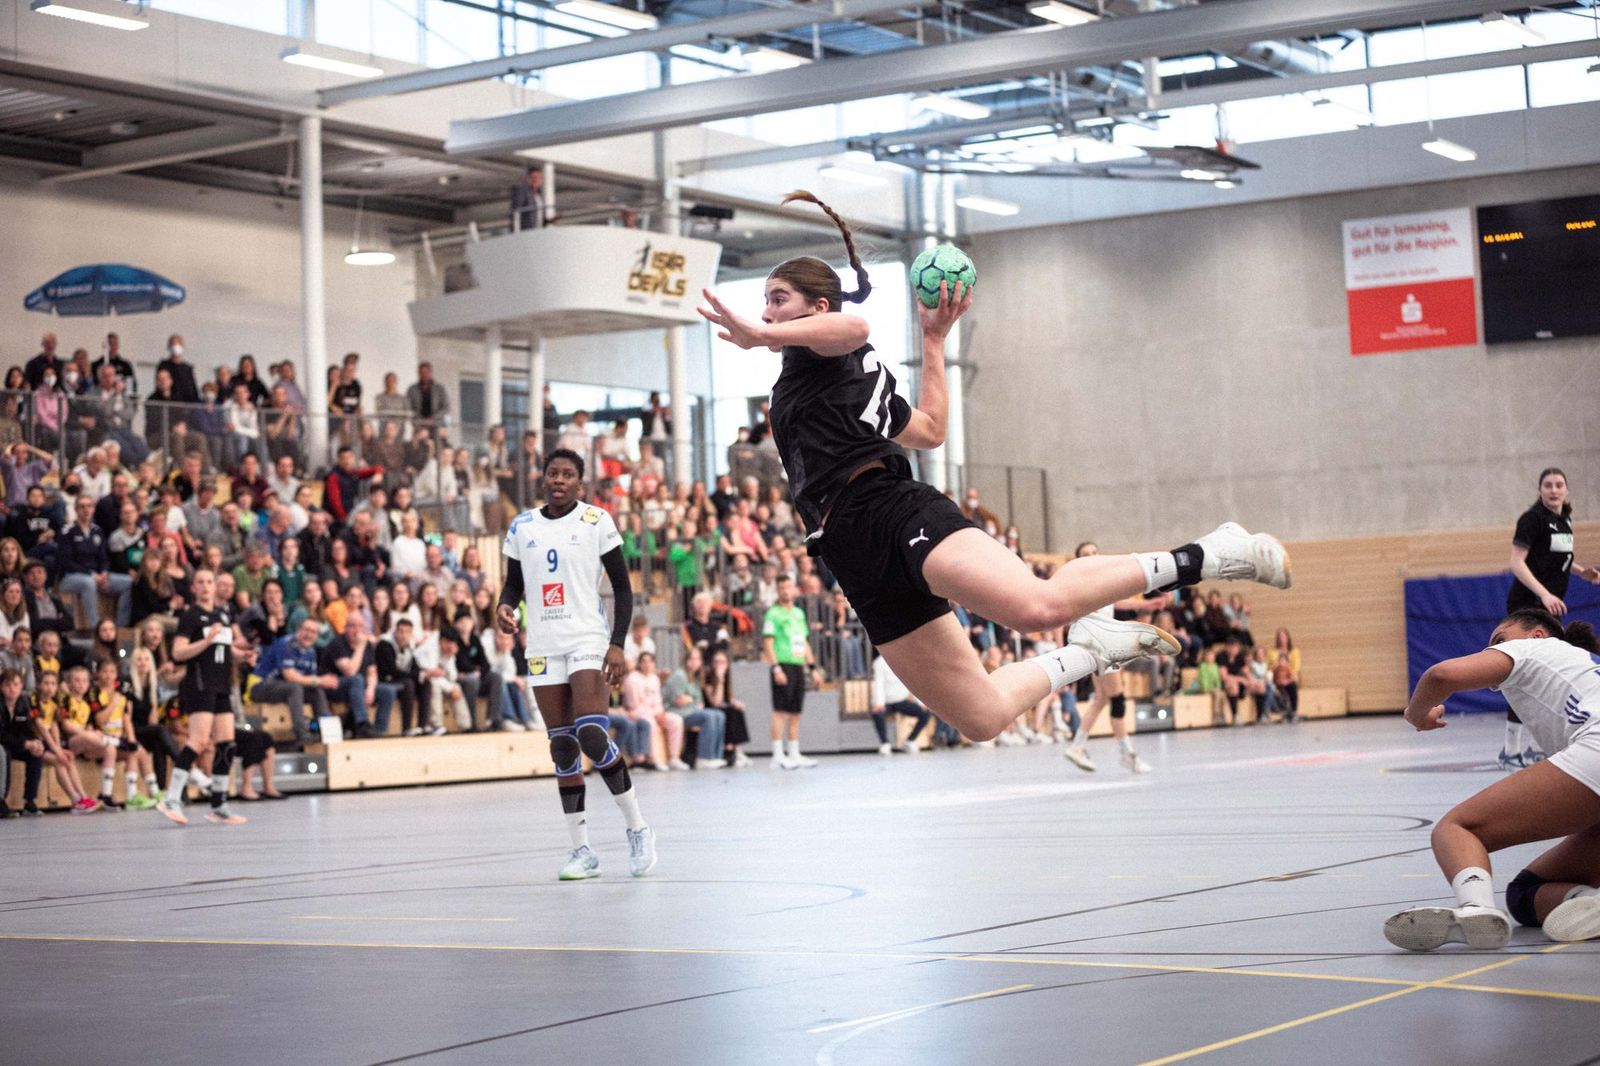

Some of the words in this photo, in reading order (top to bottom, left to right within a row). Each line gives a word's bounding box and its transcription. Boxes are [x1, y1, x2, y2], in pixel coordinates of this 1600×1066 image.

[1351, 227, 1370, 240] Gut
[1374, 225, 1391, 238] für
[1352, 245, 1371, 259] gut
[1374, 242, 1391, 255] für
[547, 549, 558, 572] 9
